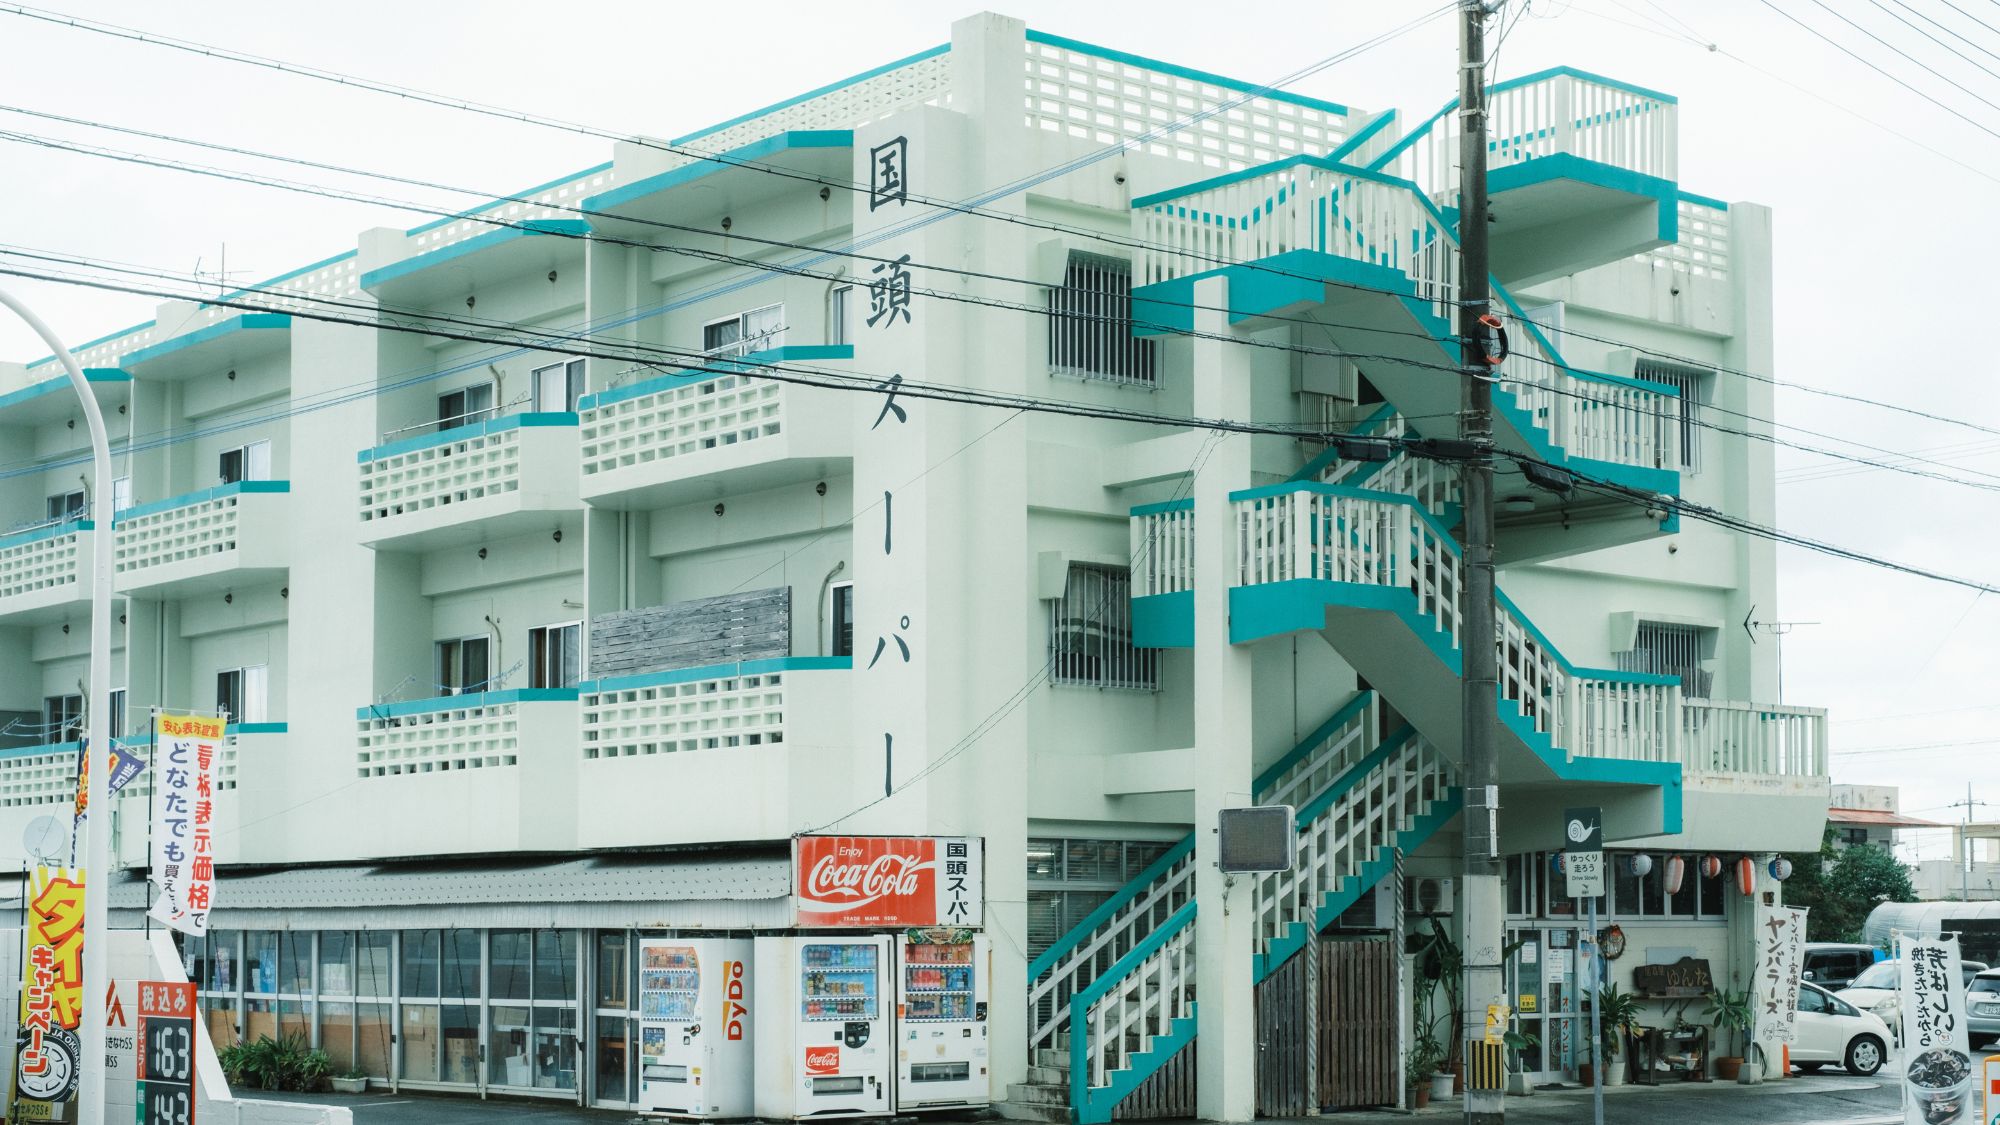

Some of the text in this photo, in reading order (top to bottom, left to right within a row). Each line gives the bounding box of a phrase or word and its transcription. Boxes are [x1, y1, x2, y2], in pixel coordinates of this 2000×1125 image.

[866, 135, 912, 798] 国頭スーパー
[163, 720, 219, 737] 安心表示宣言
[187, 744, 213, 928] 看板表示価格で
[839, 847, 863, 857] Enjoy
[1571, 854, 1598, 862] ゆっくり
[808, 854, 921, 896] Coca-Cola
[946, 843, 968, 924] 国頭スーパー
[1574, 864, 1595, 872] 走ろう
[32, 878, 85, 1029] タイヤ
[1765, 915, 1786, 1014] ヤンバラーズ
[22, 944, 54, 1076] キャンペーン
[142, 985, 187, 1012] 税込み
[51, 1029, 63, 1039] JA
[155, 1027, 190, 1079] 163
